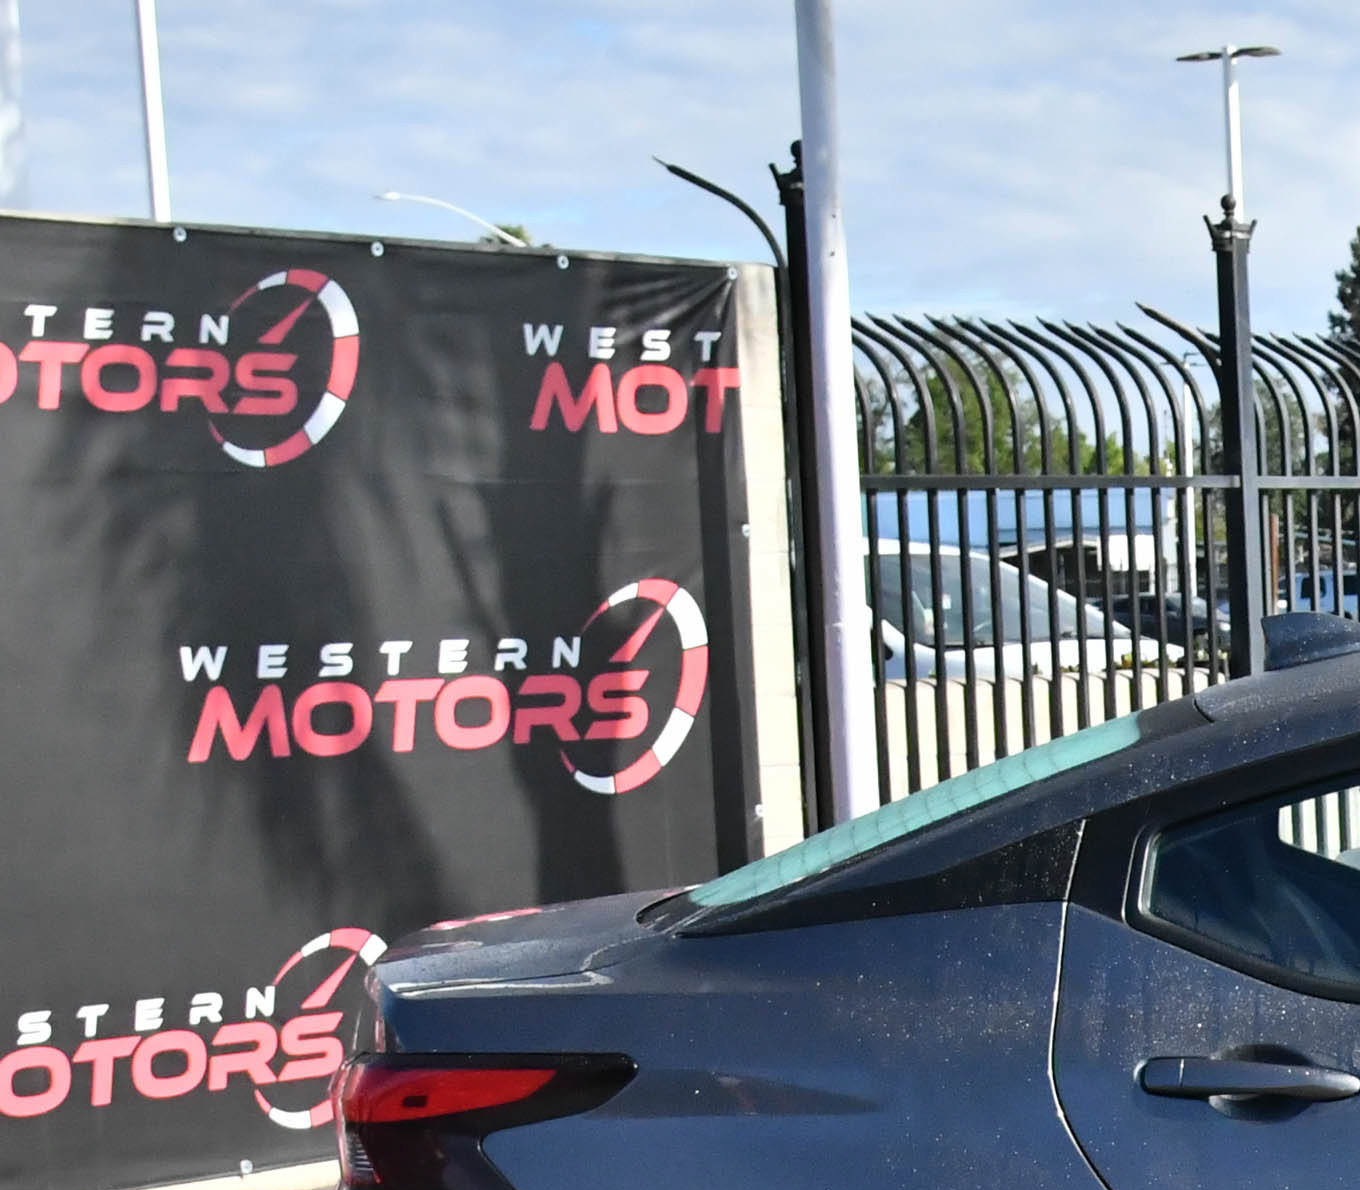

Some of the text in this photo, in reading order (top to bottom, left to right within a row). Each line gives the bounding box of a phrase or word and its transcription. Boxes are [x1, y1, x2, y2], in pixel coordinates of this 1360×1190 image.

[22, 302, 230, 345] TERN
[522, 322, 723, 363] WEST
[0, 339, 299, 415] TORS
[530, 360, 742, 436] MOT
[179, 635, 582, 683] WESTERN
[186, 668, 651, 765] MOTORS
[15, 985, 277, 1047] STERN
[0, 1010, 344, 1118] OTORS
